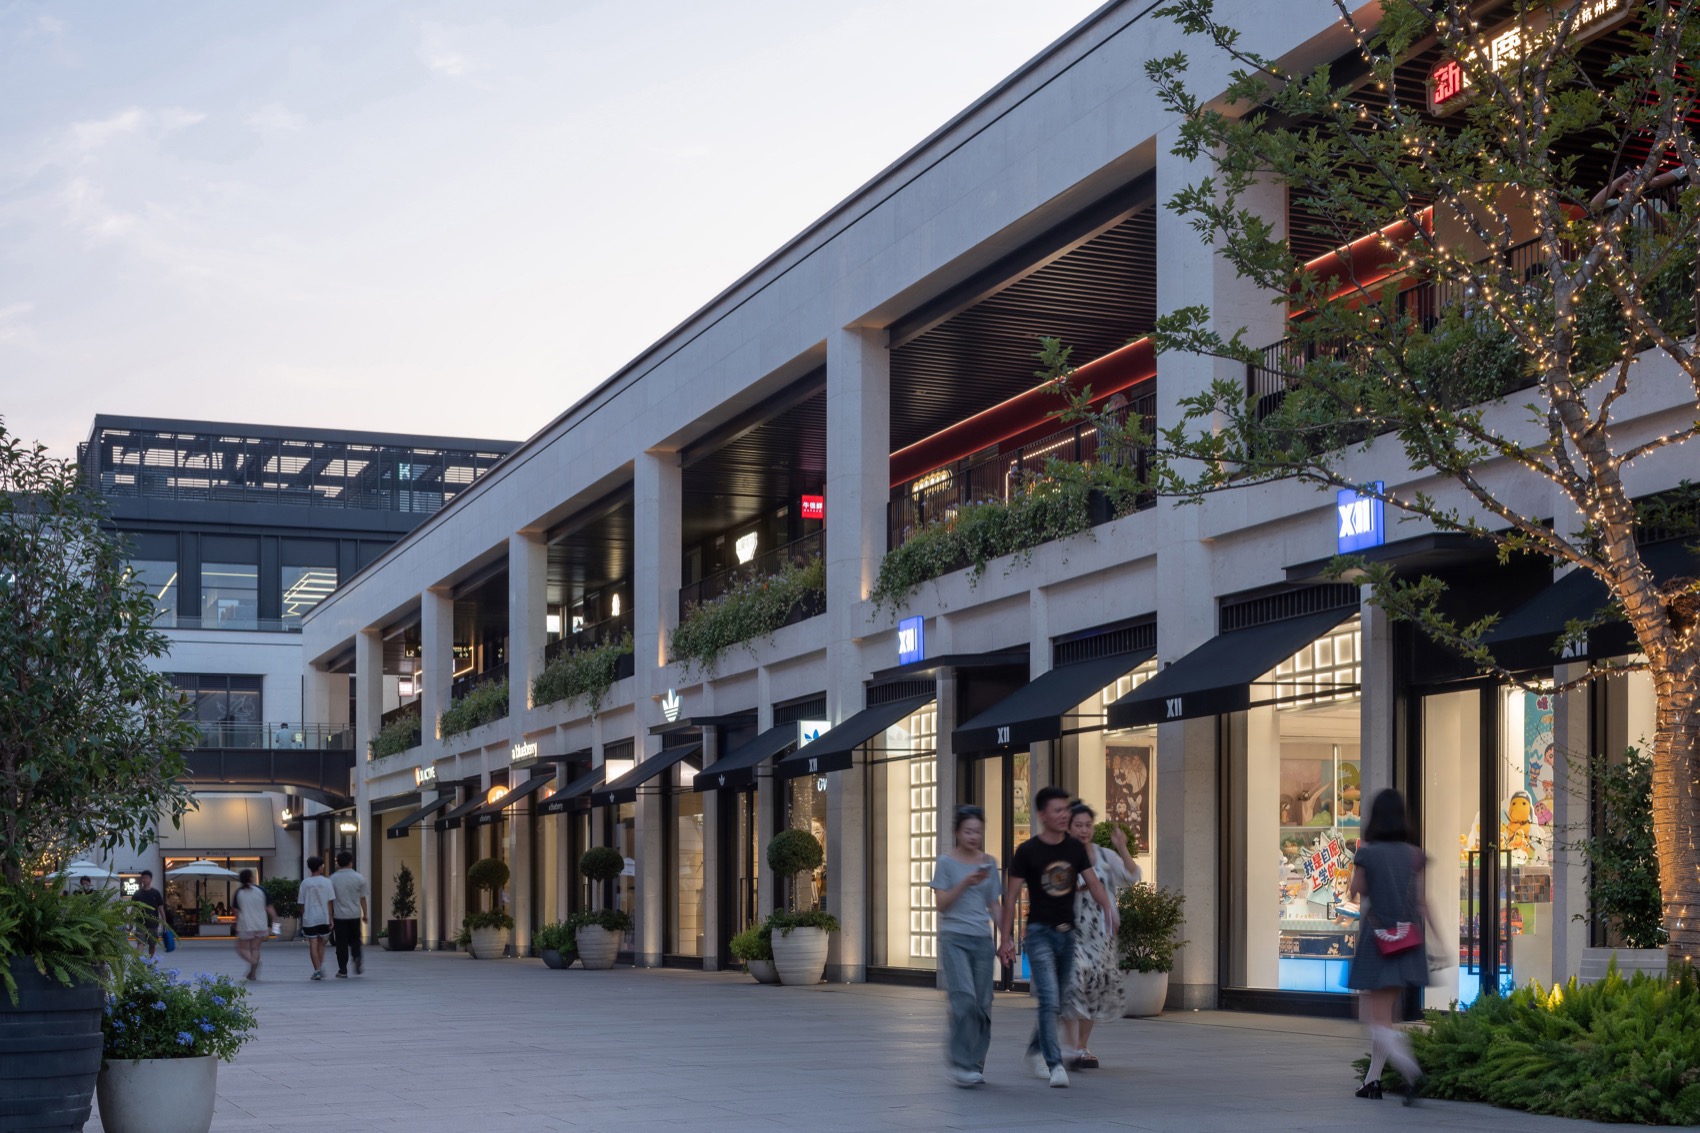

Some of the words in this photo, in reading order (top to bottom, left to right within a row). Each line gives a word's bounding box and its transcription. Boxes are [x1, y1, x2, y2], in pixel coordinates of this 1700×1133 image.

[1165, 697, 1183, 719] XII
[997, 726, 1010, 744] XII
[515, 741, 538, 758] blueberry
[1303, 839, 1341, 877] 我是自愿
